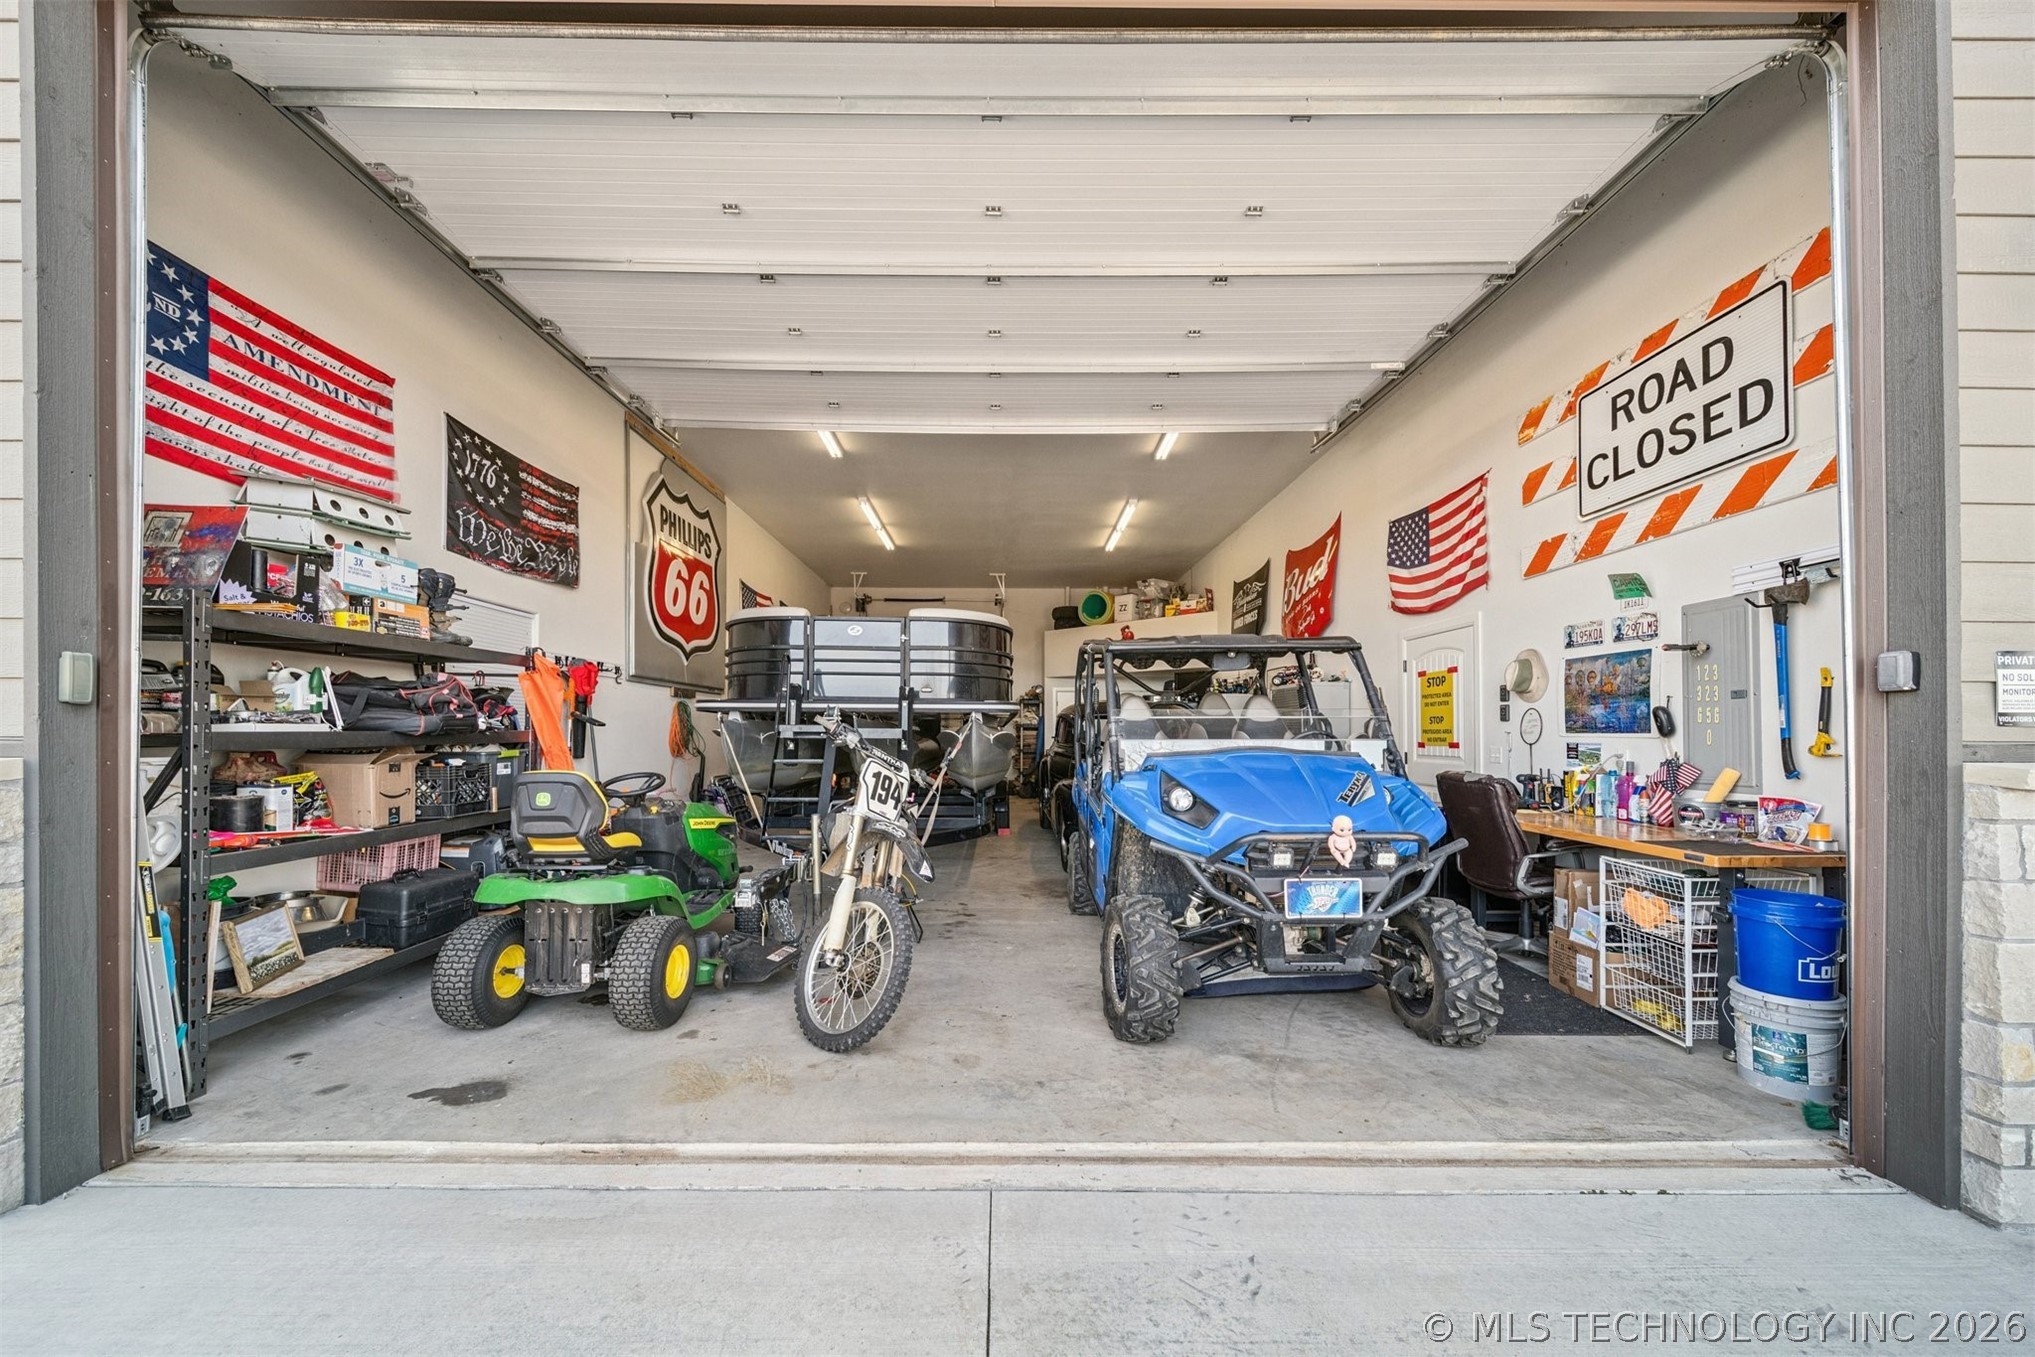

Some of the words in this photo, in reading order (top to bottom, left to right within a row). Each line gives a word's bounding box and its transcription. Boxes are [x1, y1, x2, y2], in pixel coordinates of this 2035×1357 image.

[223, 334, 382, 416] AMENDMENT
[307, 353, 373, 388] regulated
[1611, 336, 1734, 432] ROAD
[186, 382, 265, 422] security
[227, 369, 280, 396] militia
[285, 392, 318, 416] being
[1587, 378, 1774, 490] CLOSED
[465, 450, 500, 489] 1776
[456, 506, 500, 555] We
[660, 503, 712, 559] PHILLIPS
[353, 557, 364, 568] 3X
[400, 574, 406, 583] 5
[1284, 534, 1335, 614] Bud
[223, 594, 239, 602] Salt
[664, 558, 710, 625] 66
[1997, 655, 2035, 666] PRIVAT
[2002, 673, 2015, 682] NO
[1422, 692, 1441, 700] PROTECTED
[1426, 675, 1447, 688] STOP
[1429, 716, 1445, 725] STOP
[1998, 715, 2033, 723] VIOLATORS
[870, 770, 905, 811] 194
